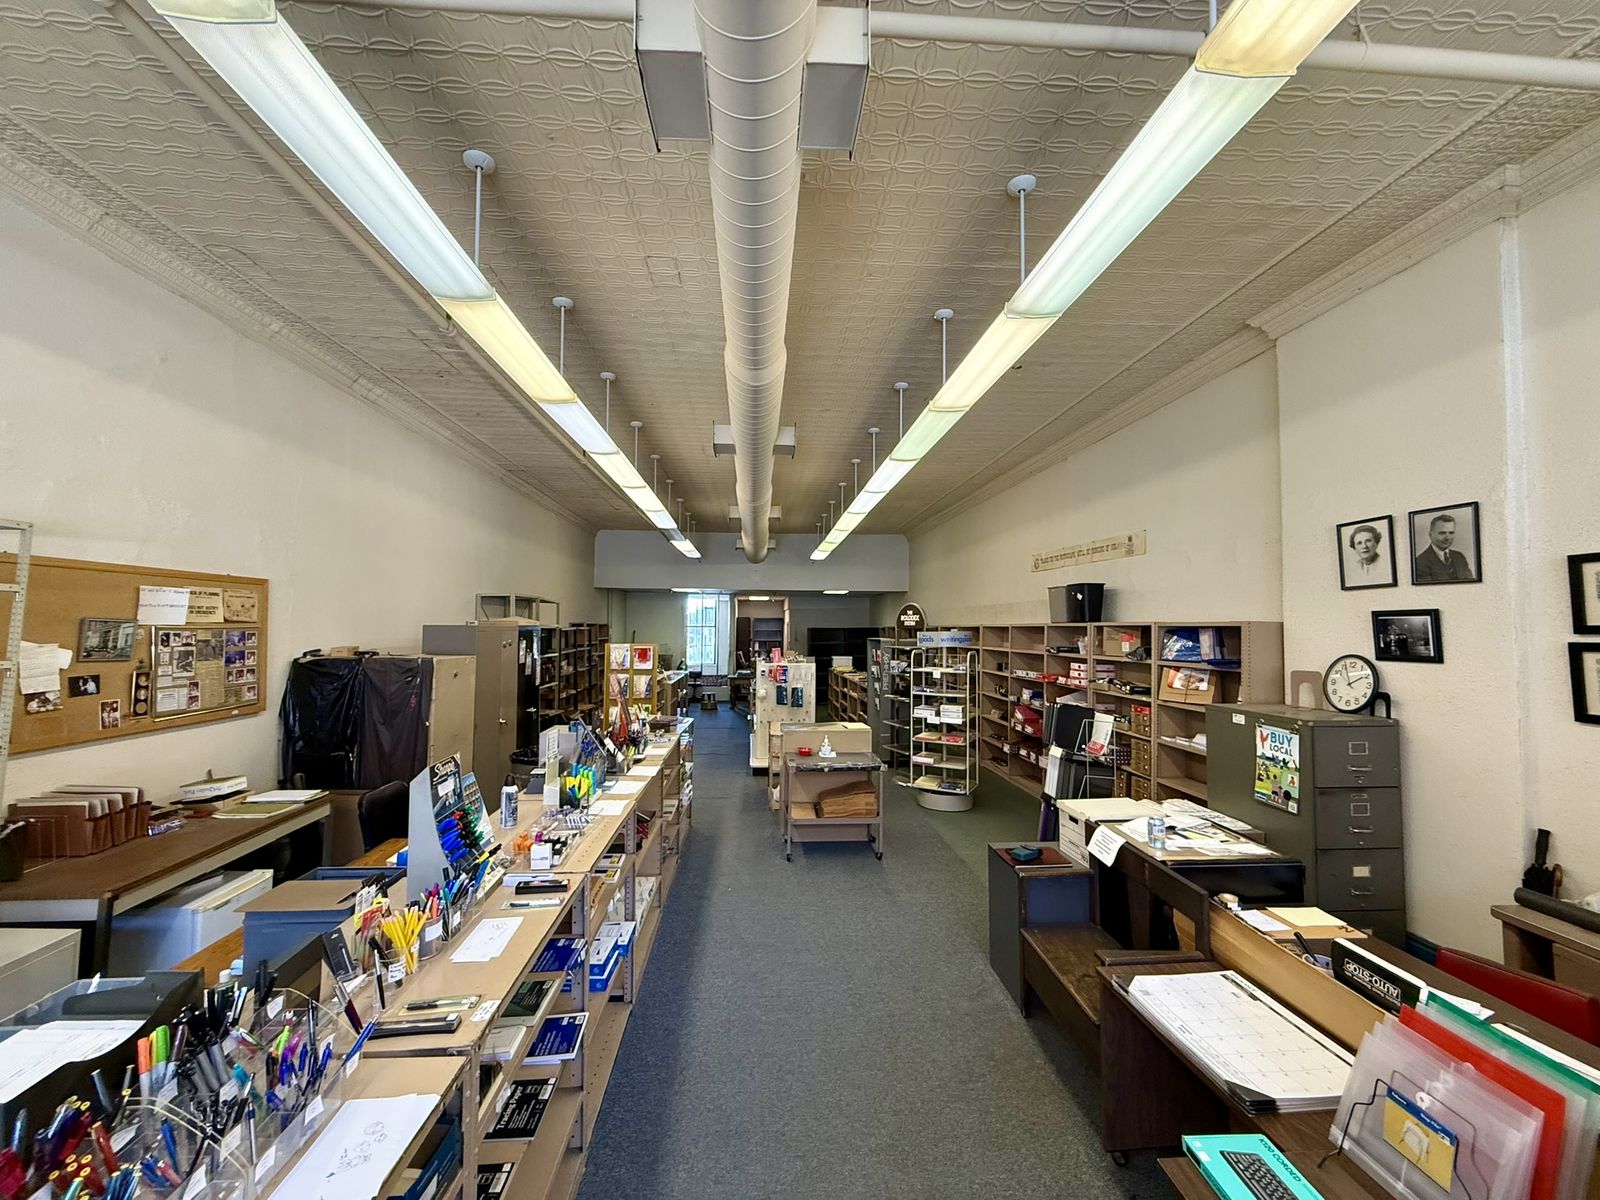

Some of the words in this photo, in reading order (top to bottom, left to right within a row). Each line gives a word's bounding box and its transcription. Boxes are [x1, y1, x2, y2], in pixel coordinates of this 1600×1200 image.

[1269, 743, 1293, 757] LOCAL
[1270, 731, 1293, 748] BUY
[495, 1103, 517, 1130] Tracing
[508, 1086, 523, 1104] Paper
[1272, 1153, 1302, 1183] CORDED
